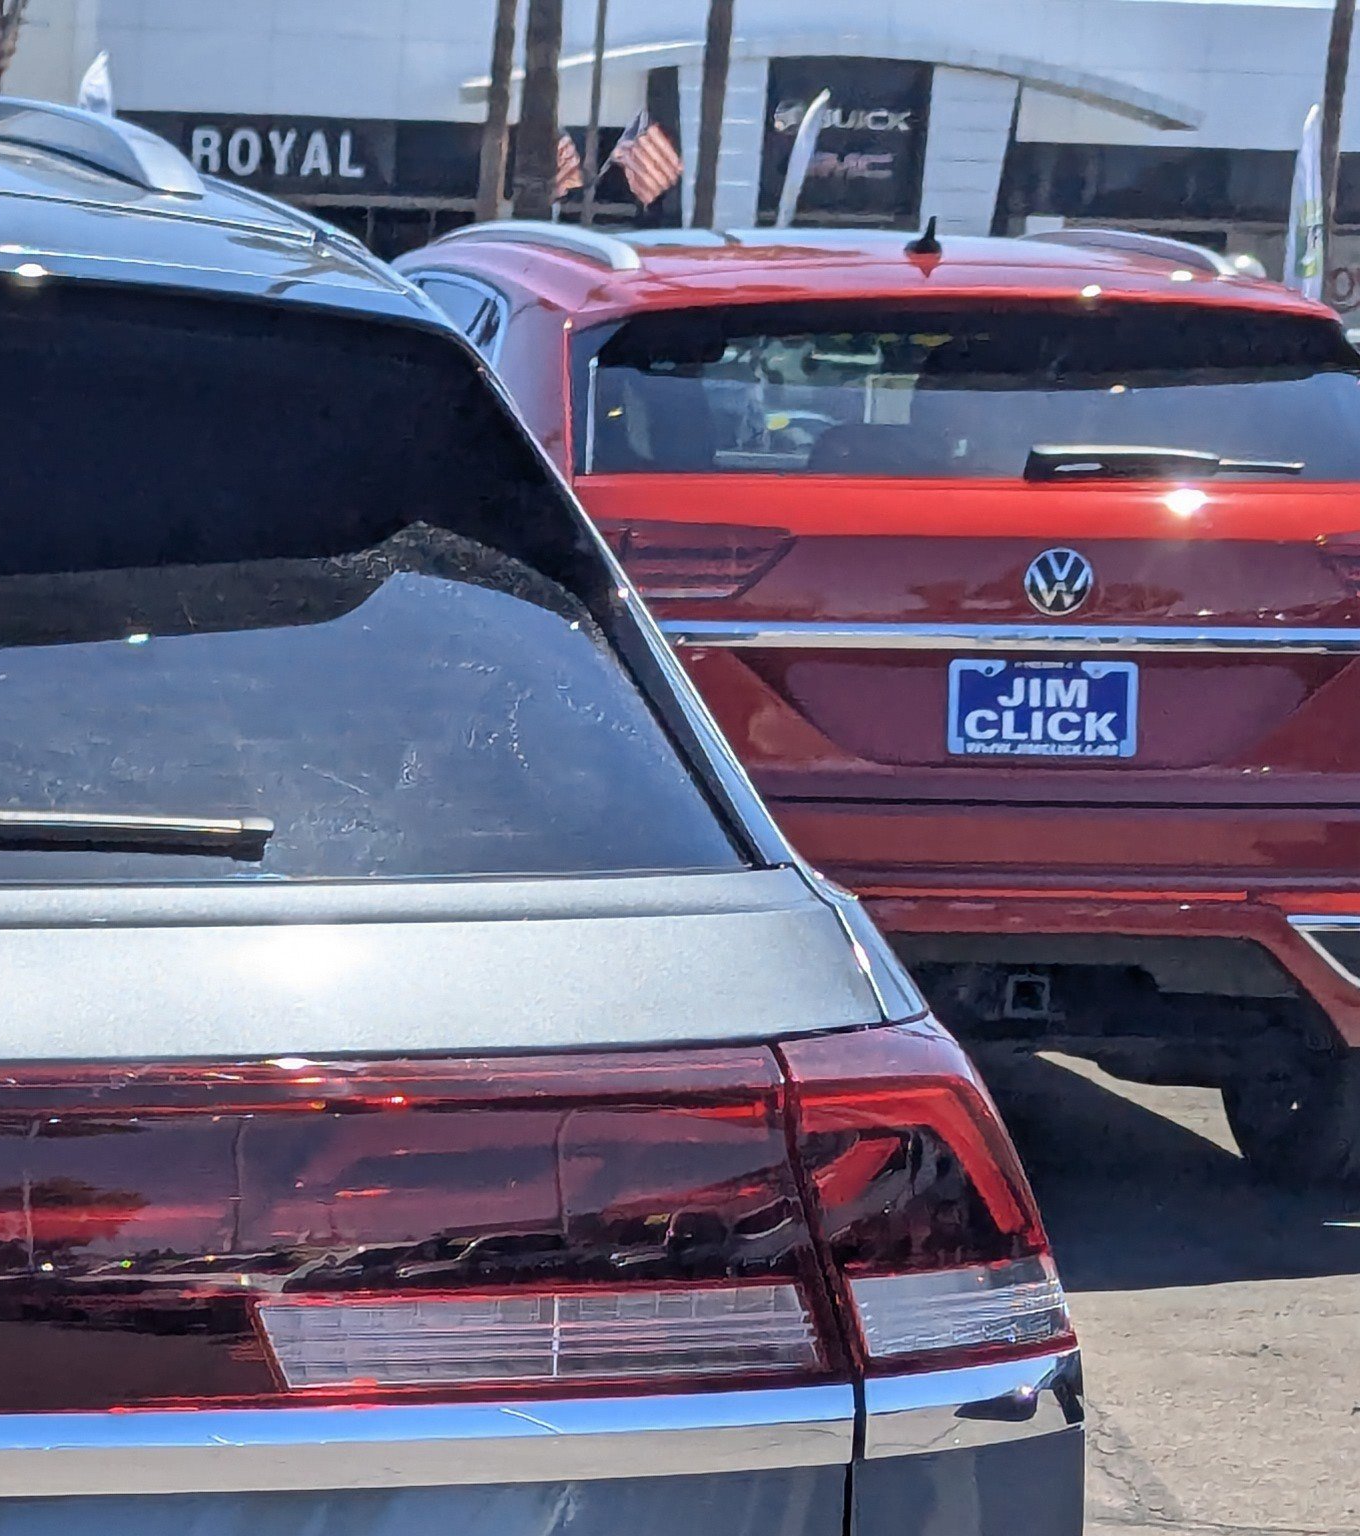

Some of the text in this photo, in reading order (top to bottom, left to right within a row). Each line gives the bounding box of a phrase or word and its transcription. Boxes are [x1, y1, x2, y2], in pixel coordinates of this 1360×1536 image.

[191, 127, 365, 179] ROYAL
[997, 677, 1088, 708] JIM
[964, 709, 1117, 742] CLICK
